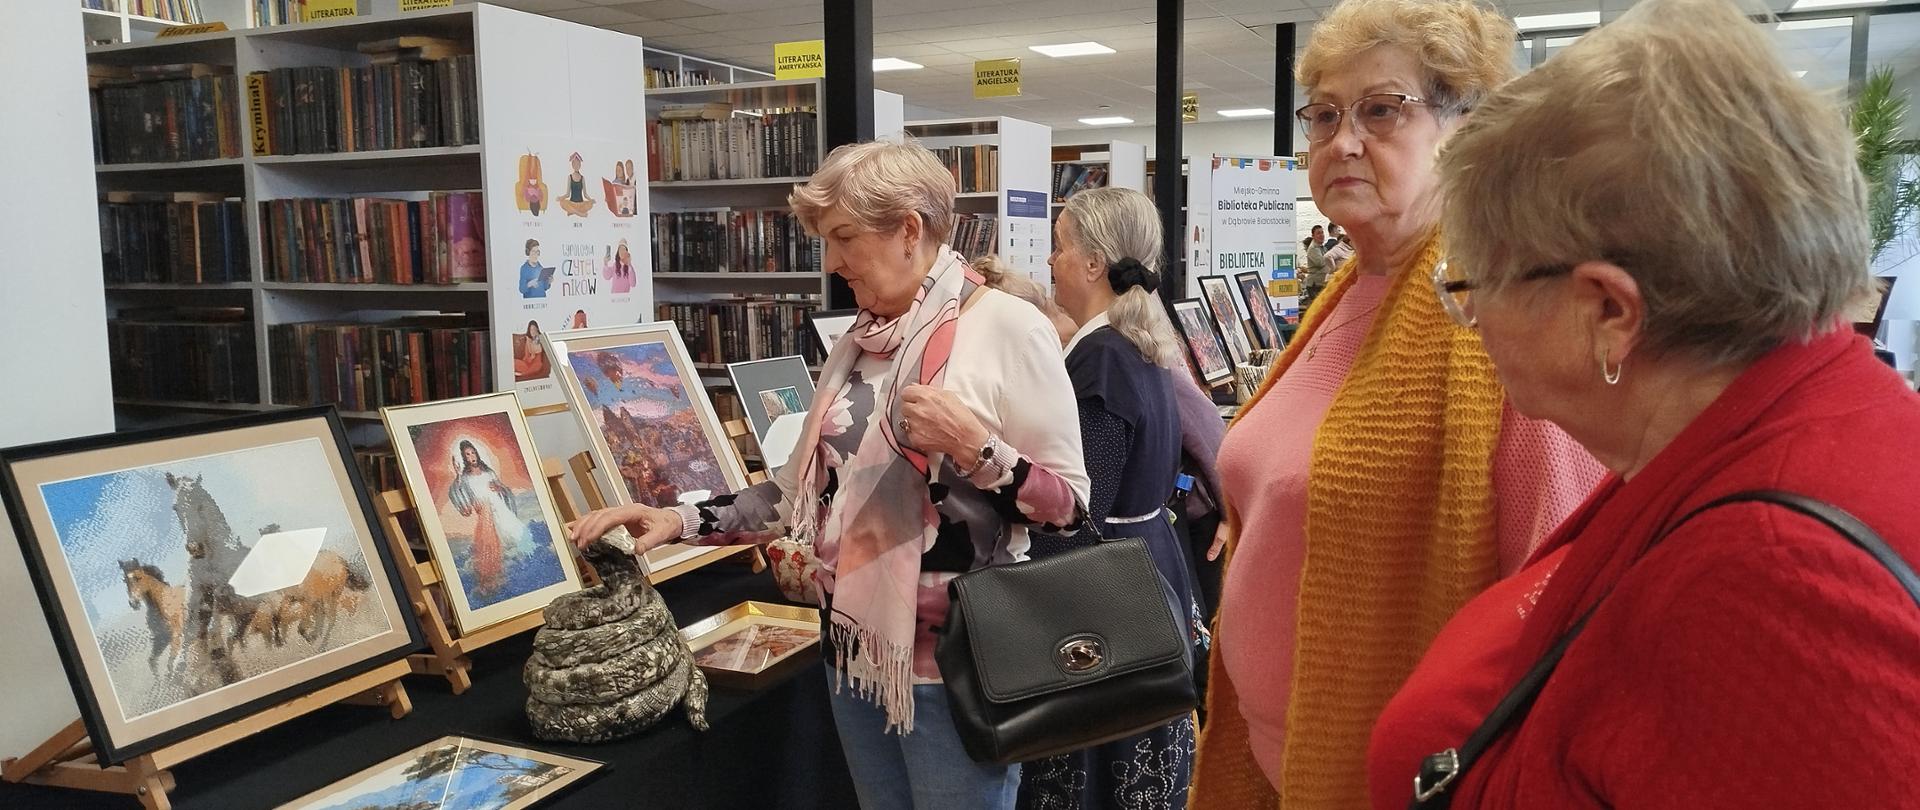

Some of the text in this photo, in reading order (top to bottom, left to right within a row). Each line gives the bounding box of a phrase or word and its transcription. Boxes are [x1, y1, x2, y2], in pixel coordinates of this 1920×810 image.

[310, 8, 354, 19] LITERATURA
[161, 25, 214, 37] Horror
[778, 53, 822, 64] LITERATURA
[976, 69, 1019, 79] LITERATURA
[976, 76, 1019, 86] ANGIELSKA
[1233, 186, 1280, 196] Miejsko-Gminna
[1218, 200, 1294, 211] Biblioteka Publiczna
[1219, 252, 1265, 269] BIBLIOTEKA
